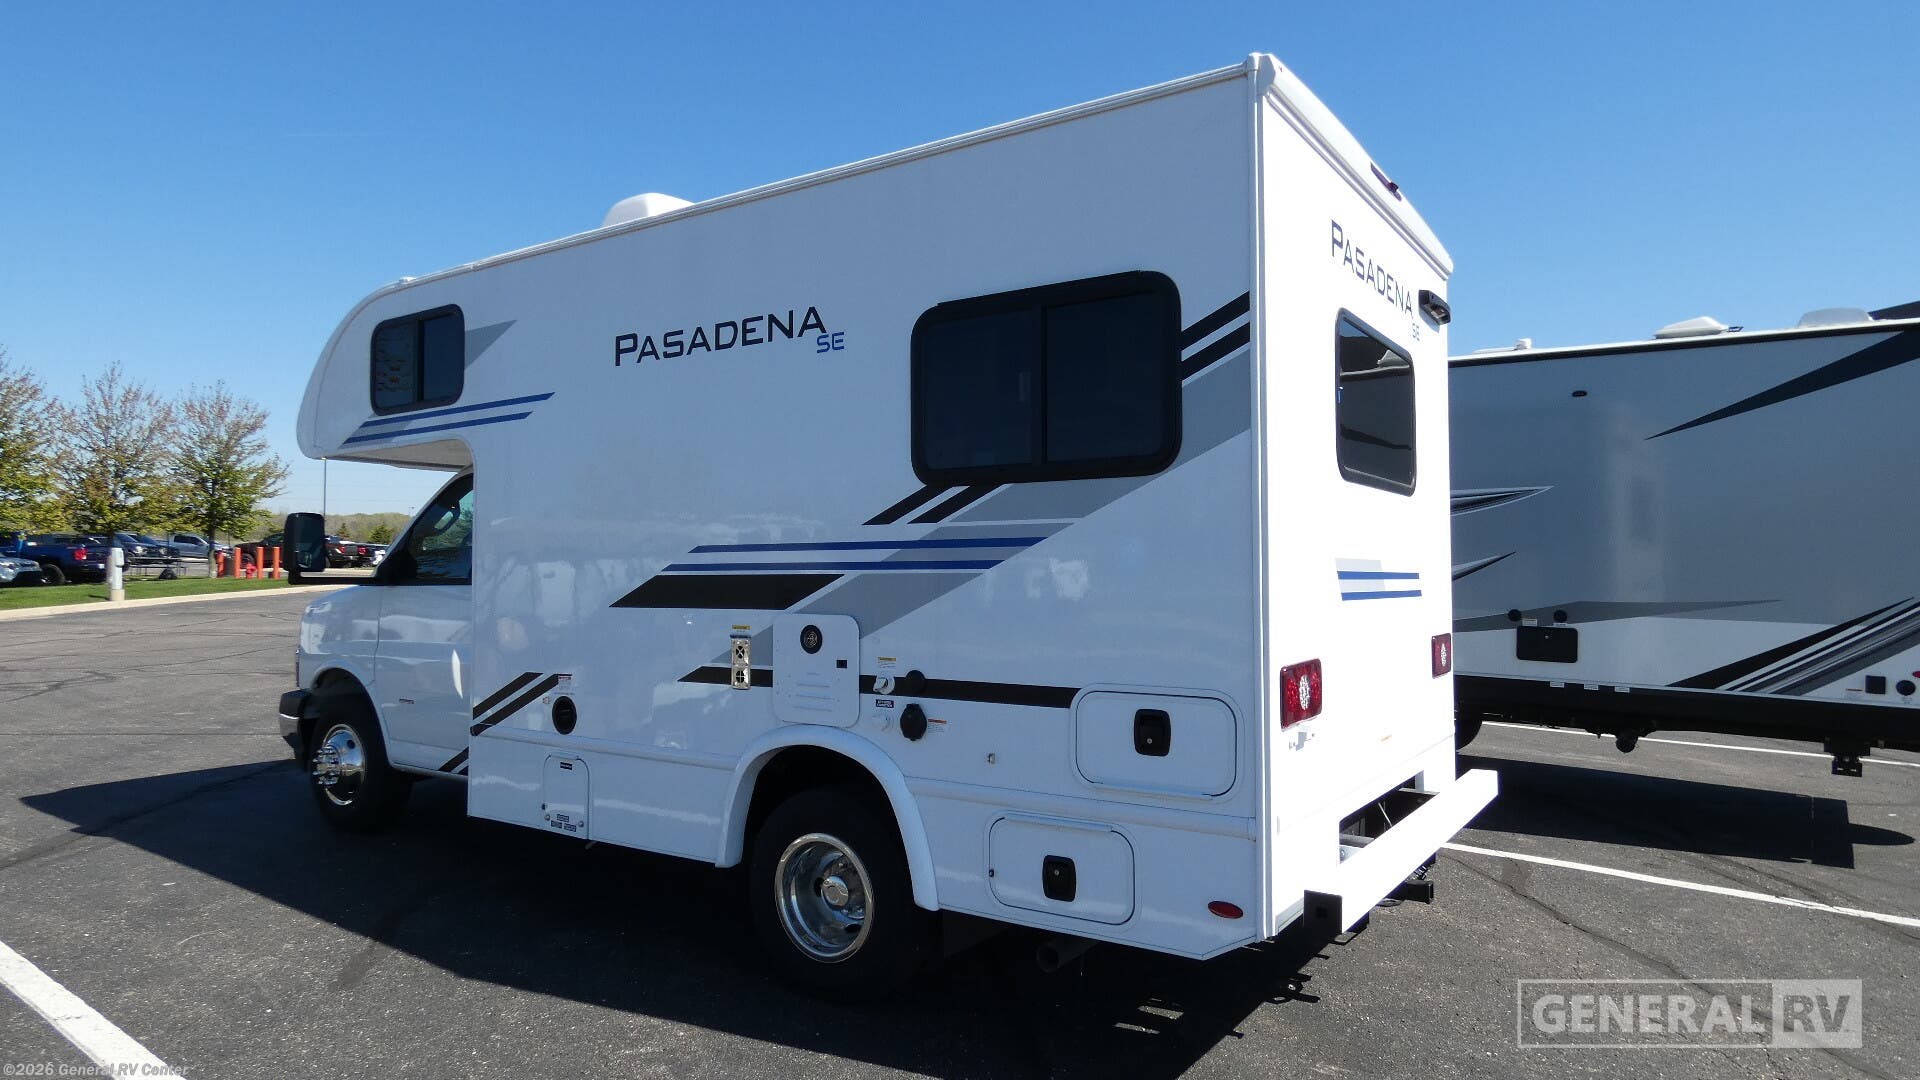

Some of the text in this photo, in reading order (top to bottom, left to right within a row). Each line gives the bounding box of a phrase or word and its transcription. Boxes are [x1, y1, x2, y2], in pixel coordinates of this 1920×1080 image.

[1331, 219, 1413, 319] PASADENA
[615, 306, 827, 367] PASADENA
[816, 332, 845, 354] SE
